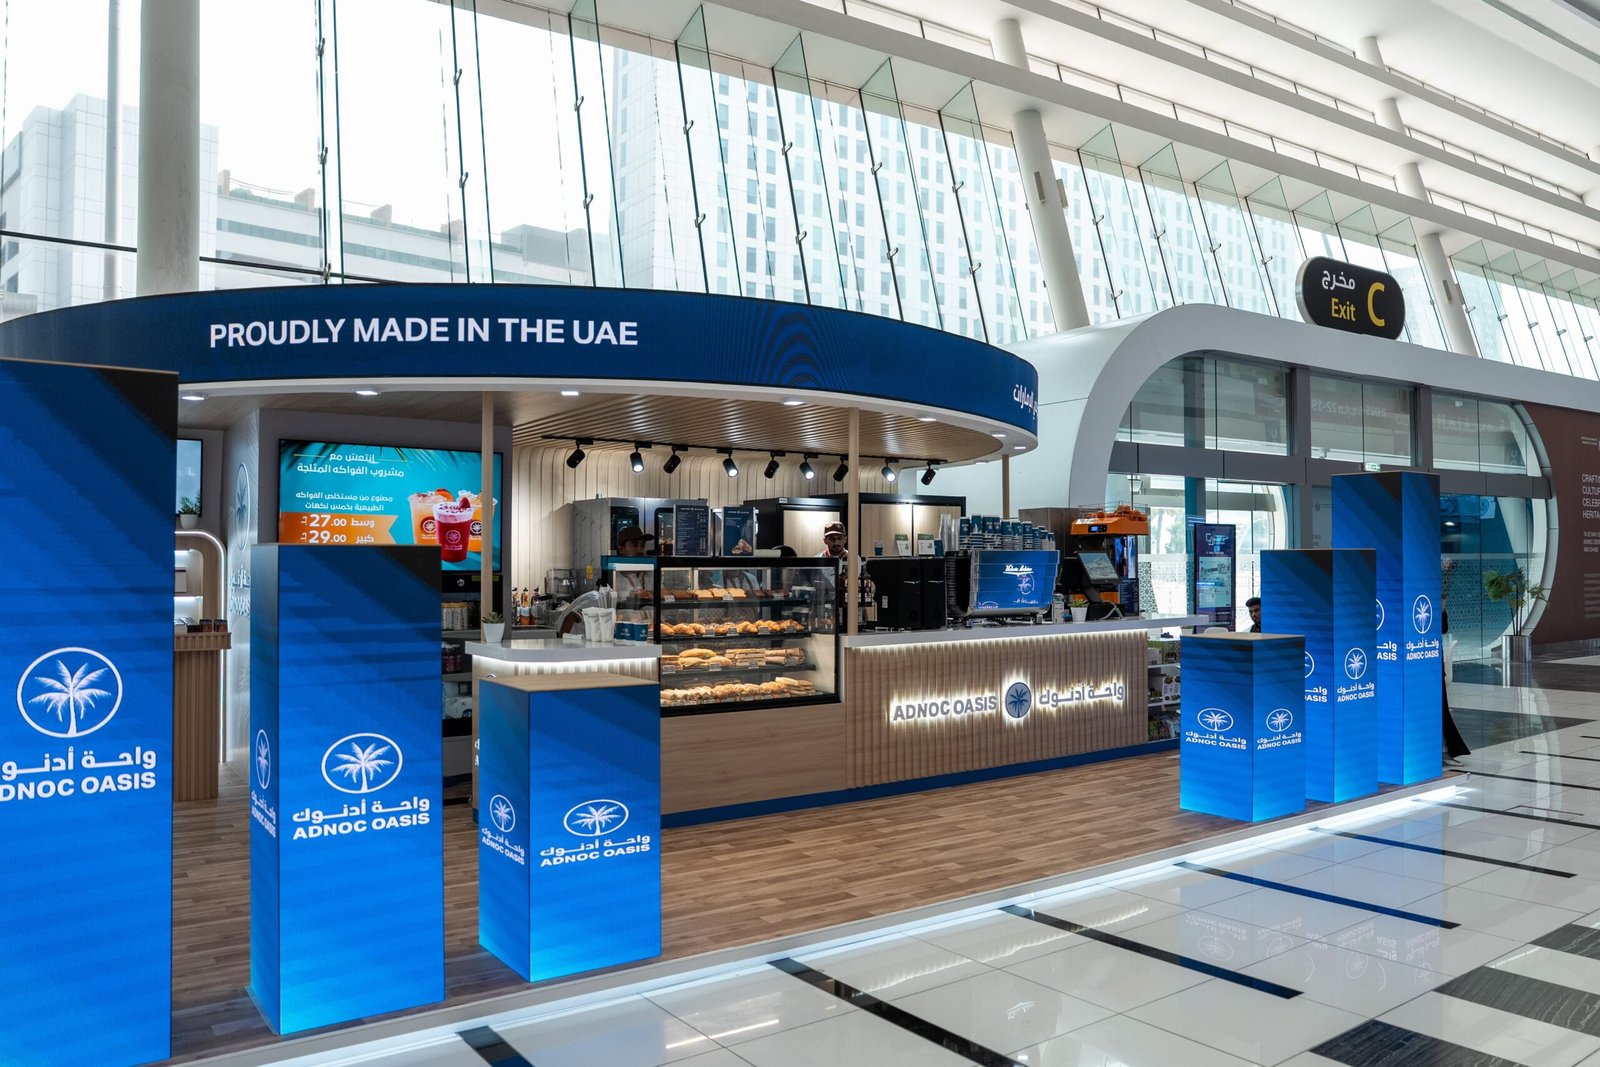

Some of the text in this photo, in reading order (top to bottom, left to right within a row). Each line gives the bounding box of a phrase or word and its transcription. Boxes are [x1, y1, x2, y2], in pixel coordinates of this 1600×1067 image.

[1322, 270, 1355, 290] مخرج
[1331, 297, 1355, 321] Exit
[1367, 282, 1386, 327] C
[210, 317, 638, 347] PROUDLY MADE IN THE UAE
[329, 452, 343, 462] مع
[297, 462, 404, 478] مشروب الفواكه المثلجة
[1582, 473, 1600, 484] CRAFTI
[295, 490, 323, 500] الفواكه
[359, 493, 370, 502] من
[370, 494, 393, 503] مصنوع
[354, 503, 384, 512] الطبيعية
[309, 513, 347, 528] 27.00
[350, 518, 375, 529] وسط
[308, 529, 347, 544] 29.00
[355, 534, 375, 544] كبير
[1377, 652, 1397, 660] ASIS
[1406, 650, 1440, 661] ADNOC OASIS
[1039, 681, 1124, 707] واحة أدنوك
[1337, 690, 1375, 703] ADNOC OASIS
[893, 694, 998, 721] ADNOC OASIS
[1185, 737, 1247, 750] ADNOC OASIS
[1257, 741, 1281, 750] ADNOC
[1, 746, 157, 781] واحة أدنو
[0, 771, 156, 802] DNOC OASIS
[292, 796, 430, 823] واحة أدنوك
[292, 812, 430, 840] ADNOC OASIS
[481, 836, 524, 865] ADNOC OASIS
[540, 834, 651, 857] واحة أدنوك
[540, 844, 651, 867] ADNOC OASIS
